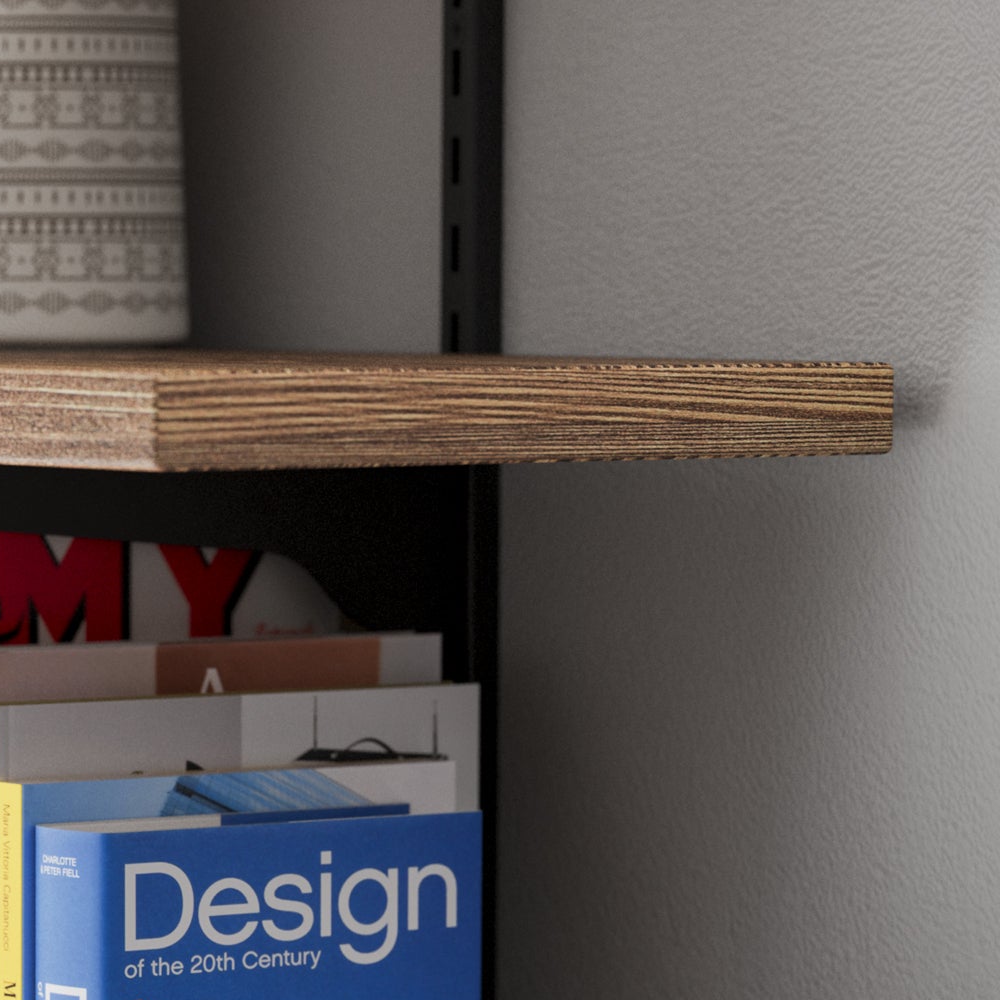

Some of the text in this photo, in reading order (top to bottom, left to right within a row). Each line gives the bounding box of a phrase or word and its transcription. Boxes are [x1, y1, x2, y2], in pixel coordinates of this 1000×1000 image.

[42, 854, 77, 867] CHARLOTTE
[124, 850, 458, 965] Design
[124, 949, 322, 979] of the 20th Century
[37, 981, 43, 997] of
